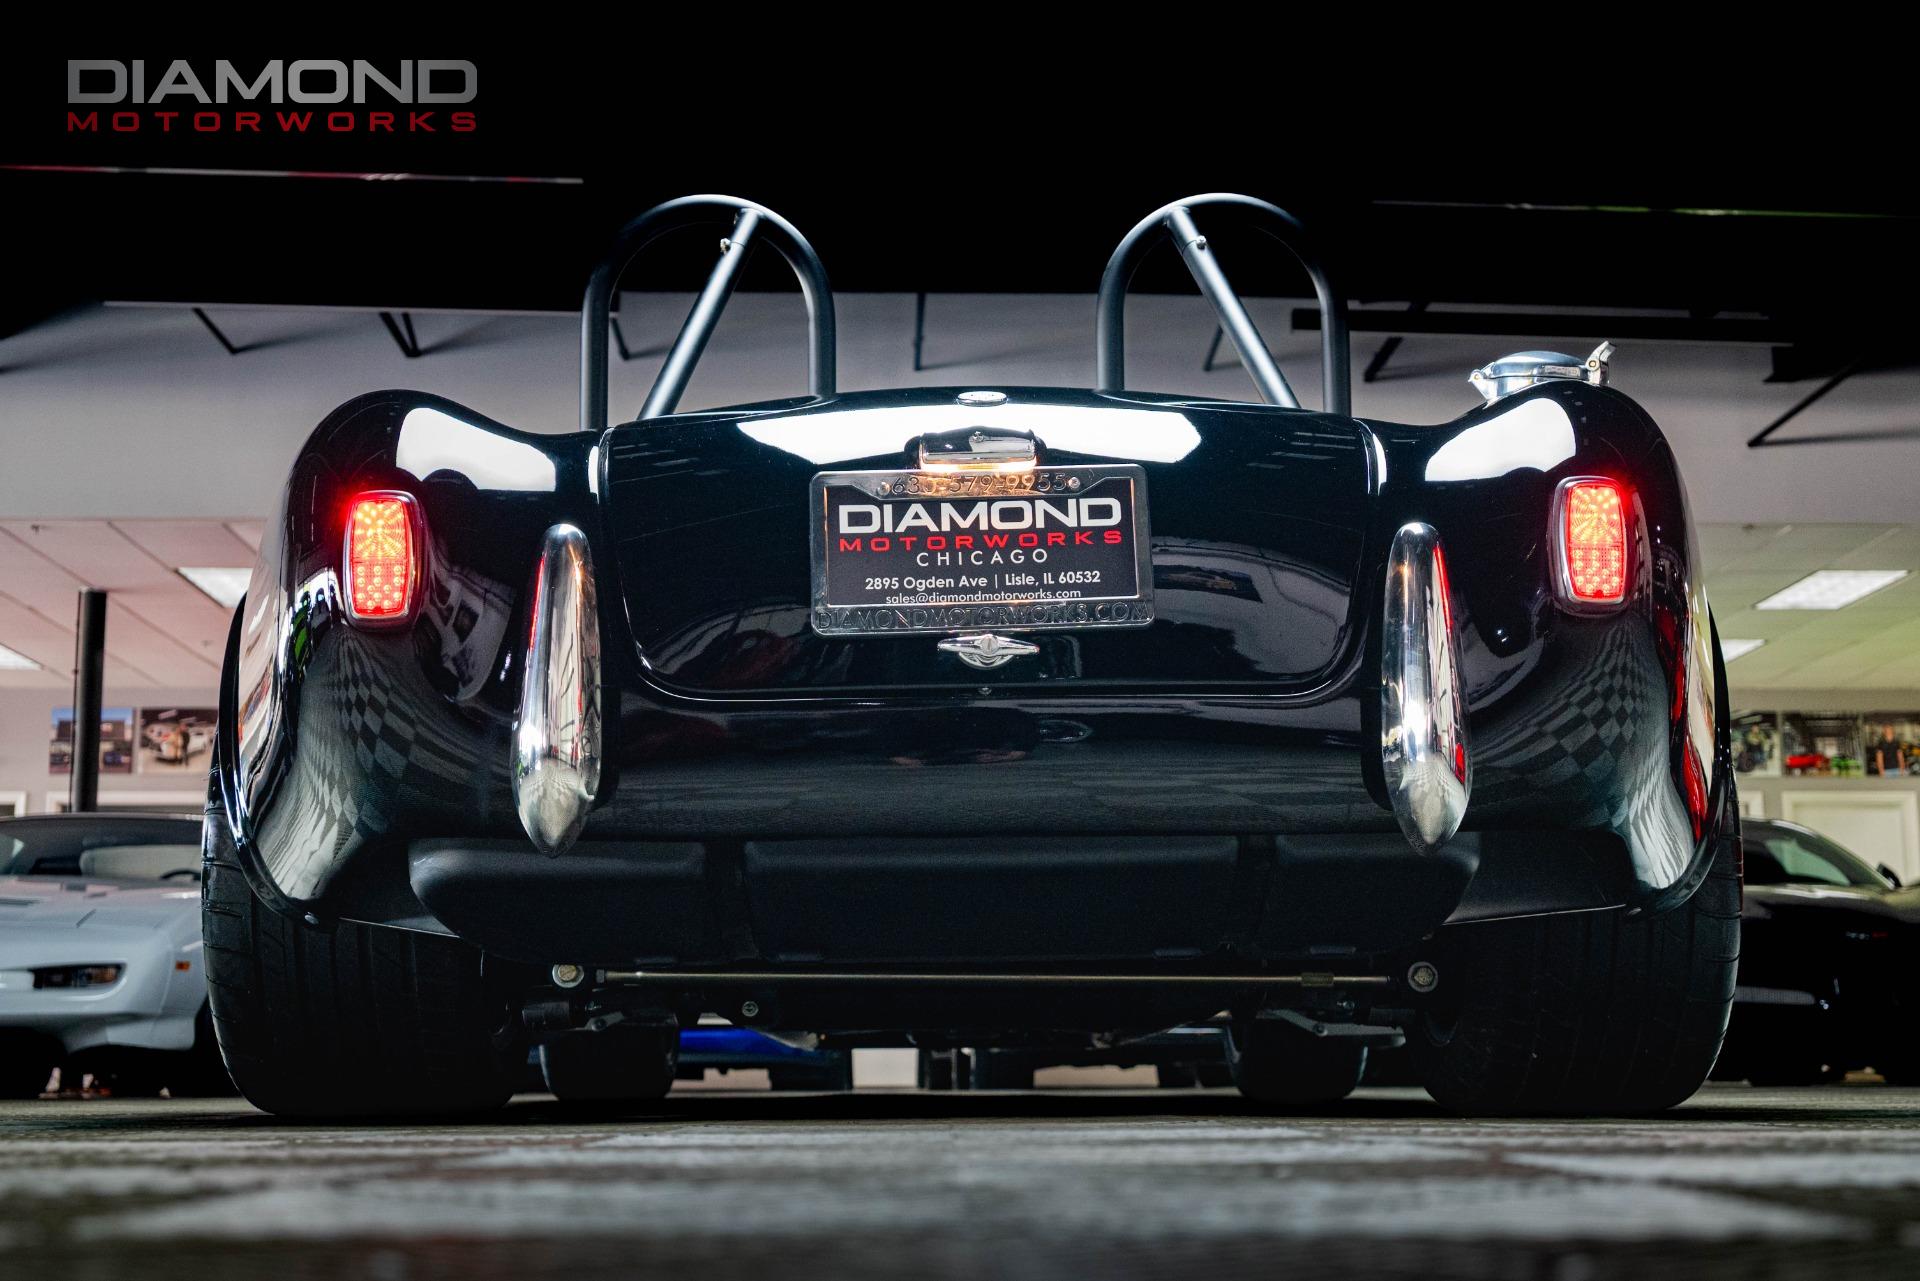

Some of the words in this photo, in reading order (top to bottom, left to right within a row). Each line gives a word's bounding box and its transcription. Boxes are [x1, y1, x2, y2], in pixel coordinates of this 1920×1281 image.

[891, 473, 1067, 495] 630-579-9955
[838, 498, 1122, 534] DIAMOND
[839, 530, 1123, 553] MOTORWORKS
[917, 549, 1048, 567] CHICAGO
[865, 577, 899, 591] 2895
[903, 576, 954, 592] Ogden
[959, 575, 988, 588] Ave
[1005, 573, 1039, 586] Lisle,
[1043, 572, 1054, 585] IL
[1058, 570, 1101, 584] 60532
[886, 588, 1081, 605] sales@diamondmotorworks.com
[817, 602, 1151, 630] DIAMONDMOTORWORKS.COM
